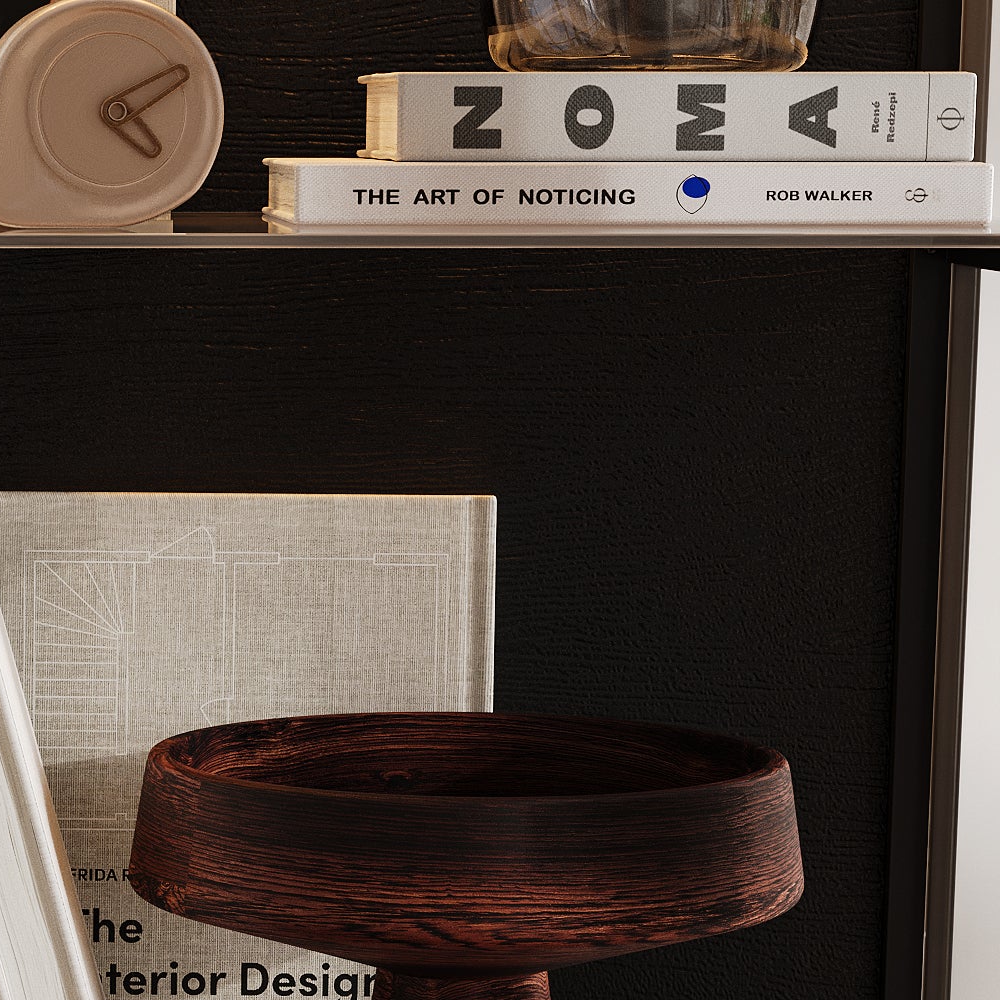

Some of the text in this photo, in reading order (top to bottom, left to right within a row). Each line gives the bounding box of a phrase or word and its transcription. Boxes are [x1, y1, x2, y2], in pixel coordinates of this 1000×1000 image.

[453, 84, 839, 150] NOMA
[871, 101, 880, 133] René
[886, 92, 896, 142] Redzepi
[352, 189, 636, 205] THE ART OF NOTICING
[766, 190, 873, 201] ROB WALKER
[82, 908, 143, 943] he
[99, 962, 227, 996] terior
